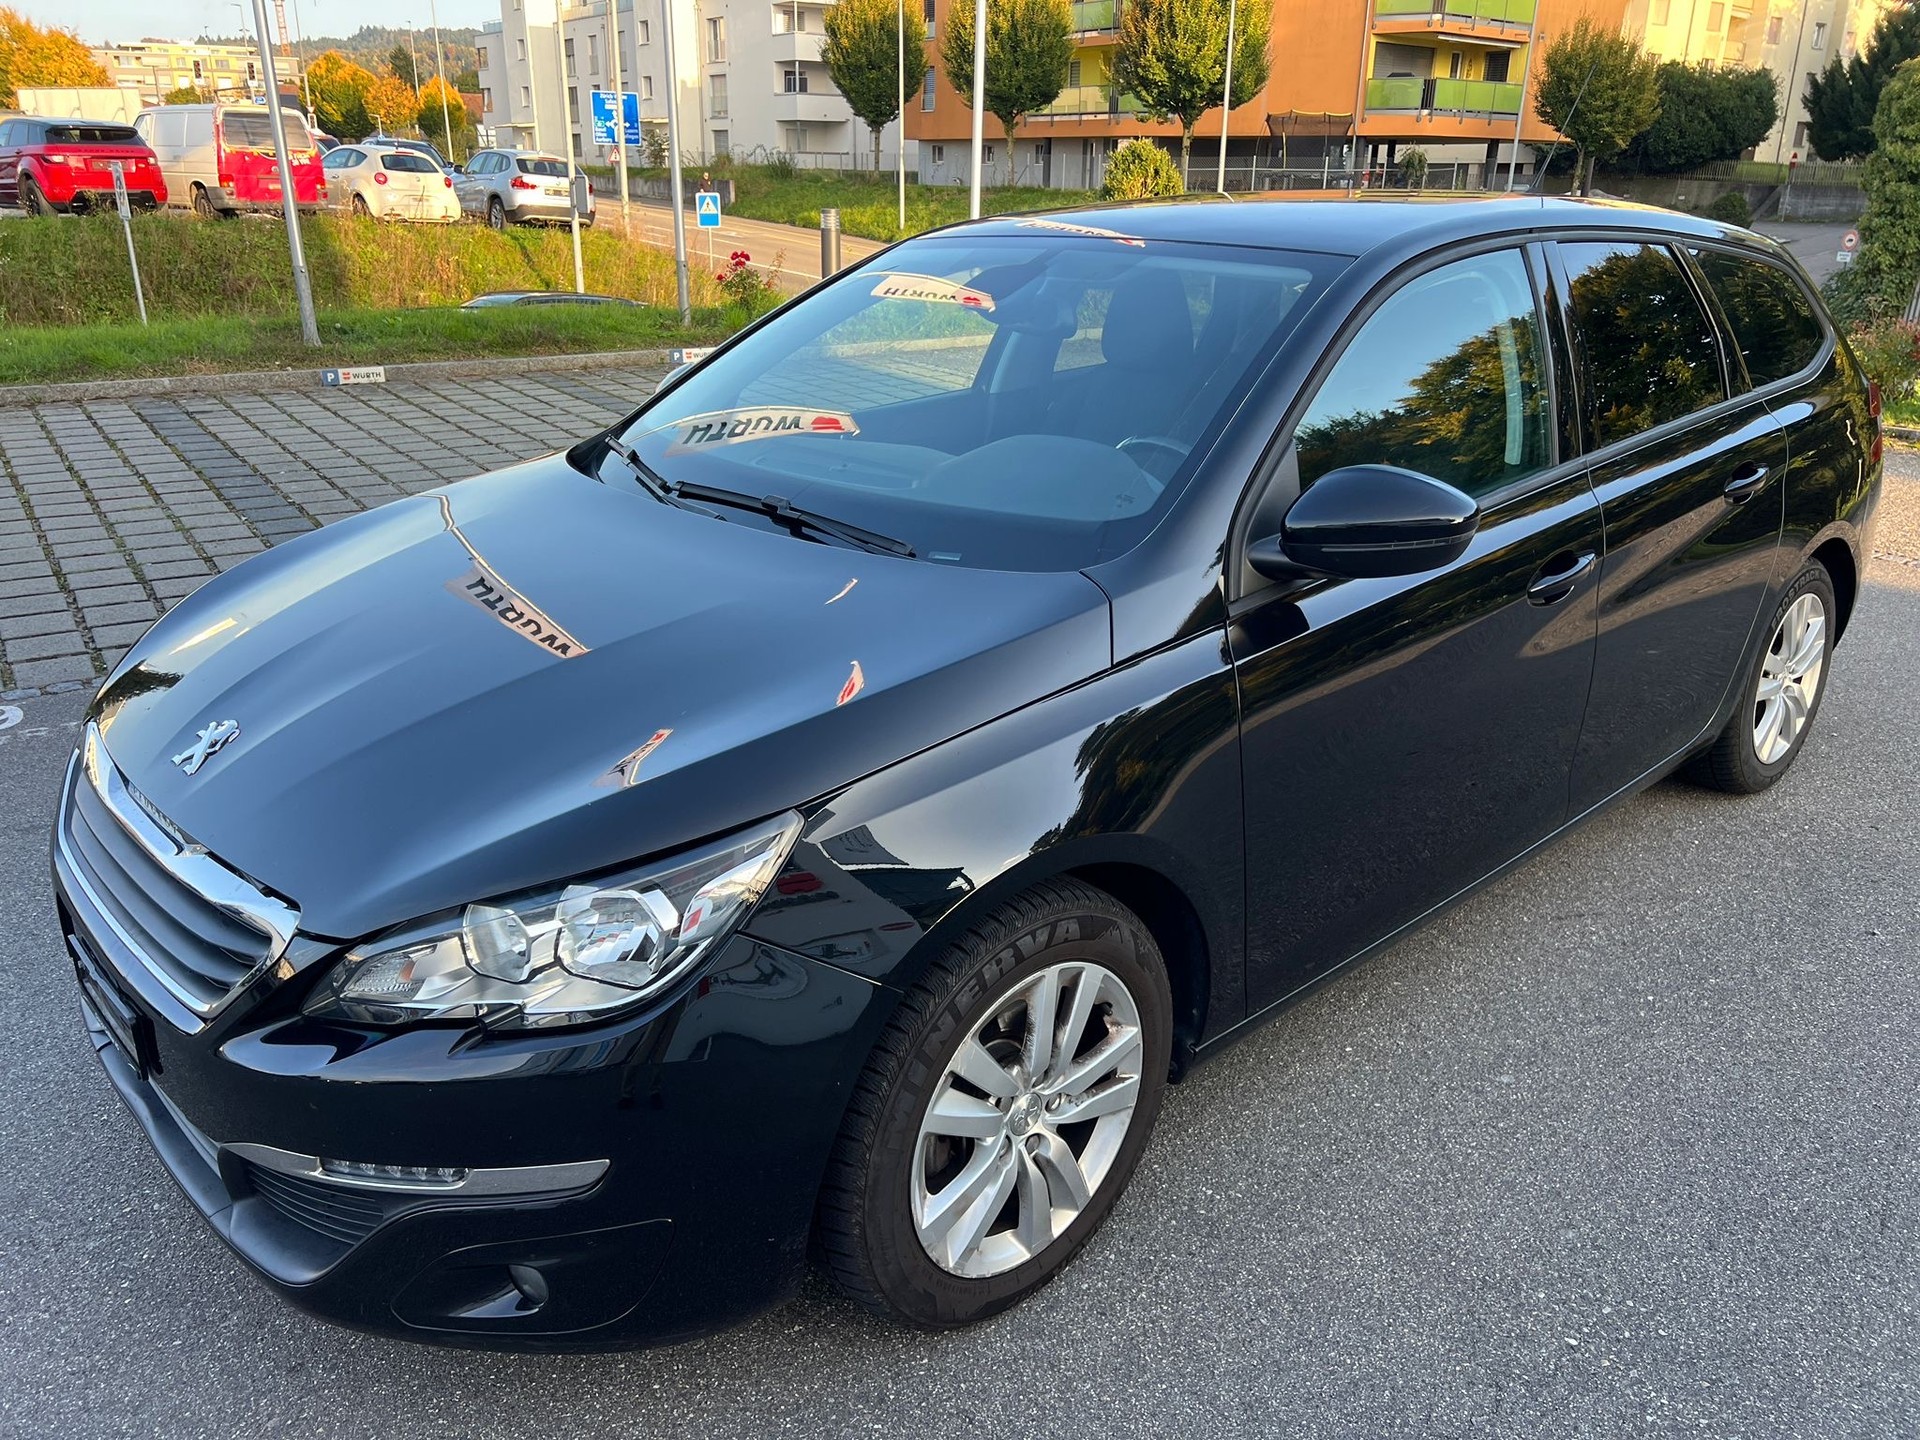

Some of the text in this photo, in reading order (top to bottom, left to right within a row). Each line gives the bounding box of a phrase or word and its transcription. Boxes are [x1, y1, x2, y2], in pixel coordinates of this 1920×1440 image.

[673, 352, 680, 361] P
[326, 373, 335, 382] P
[884, 917, 1081, 1152] MINERVA
